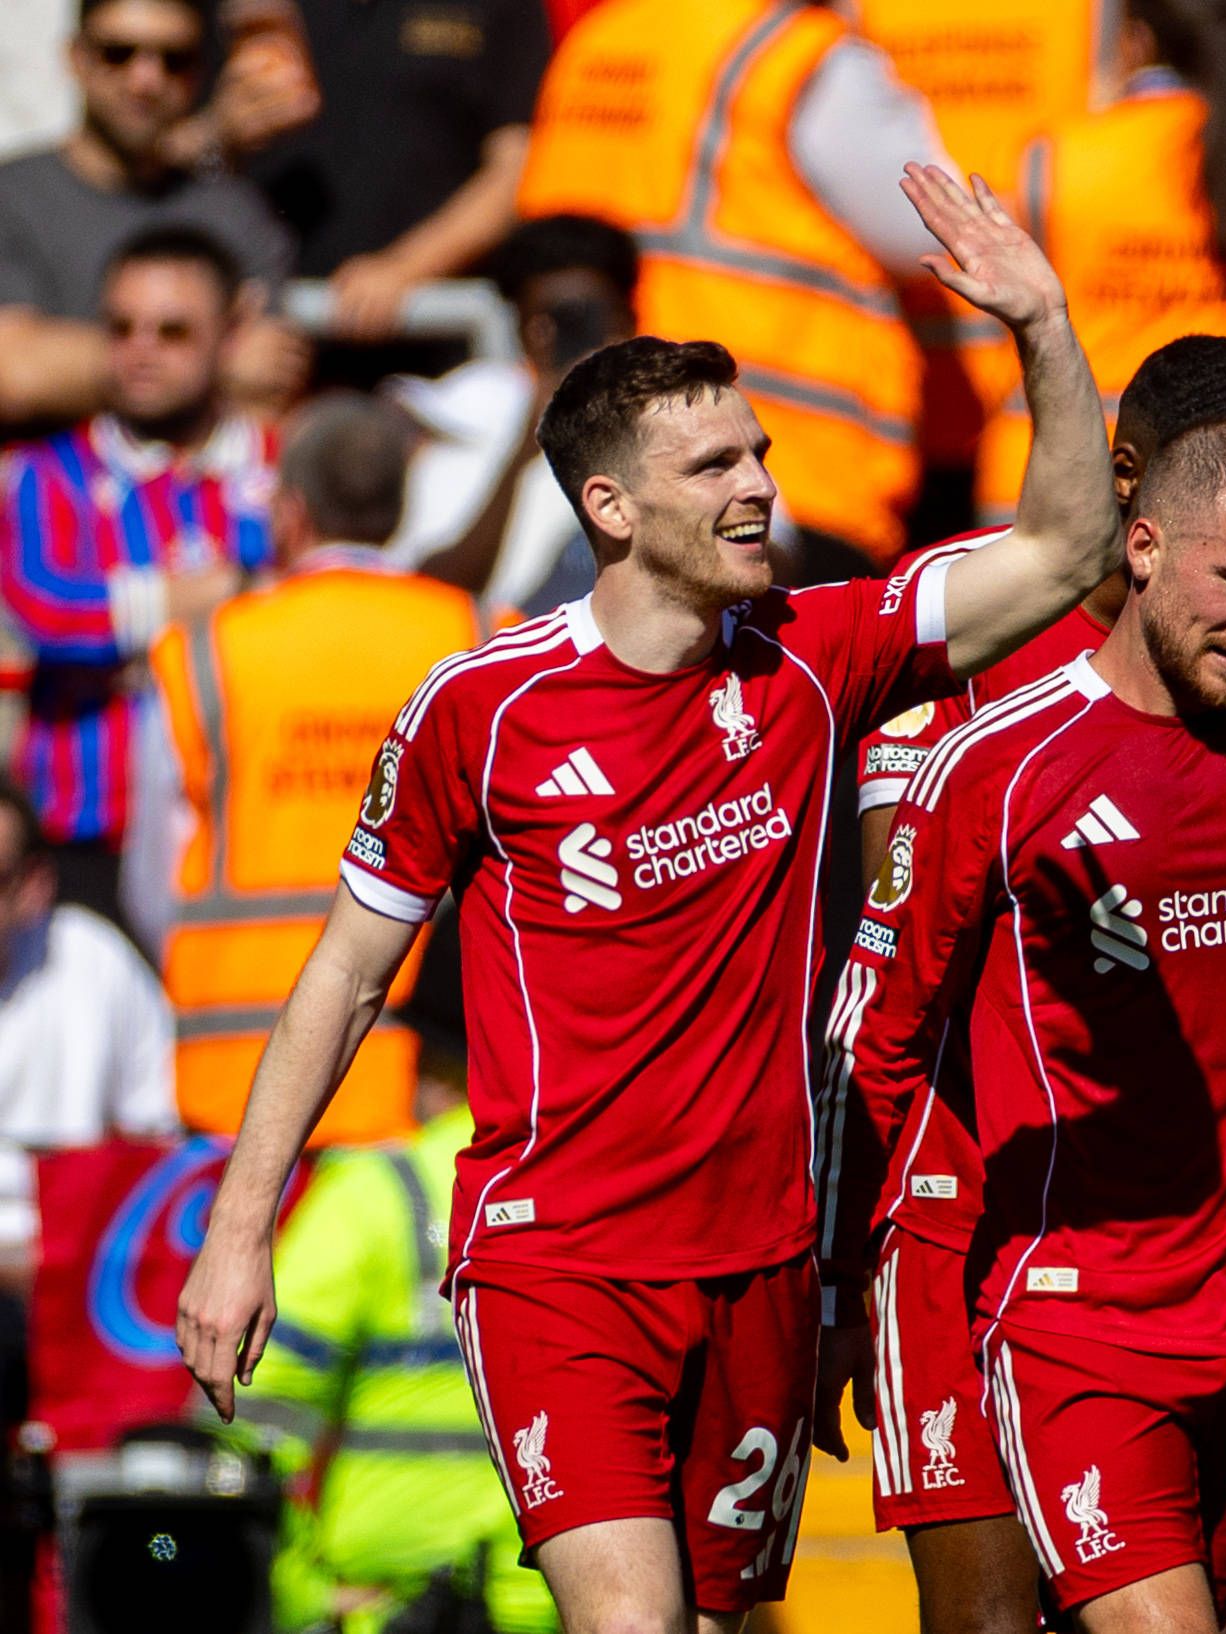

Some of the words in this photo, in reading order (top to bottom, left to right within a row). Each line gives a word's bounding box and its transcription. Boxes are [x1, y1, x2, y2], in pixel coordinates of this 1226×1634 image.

[626, 781, 773, 861] standard
[633, 807, 793, 889] chartered
[707, 1415, 805, 1531] 26
